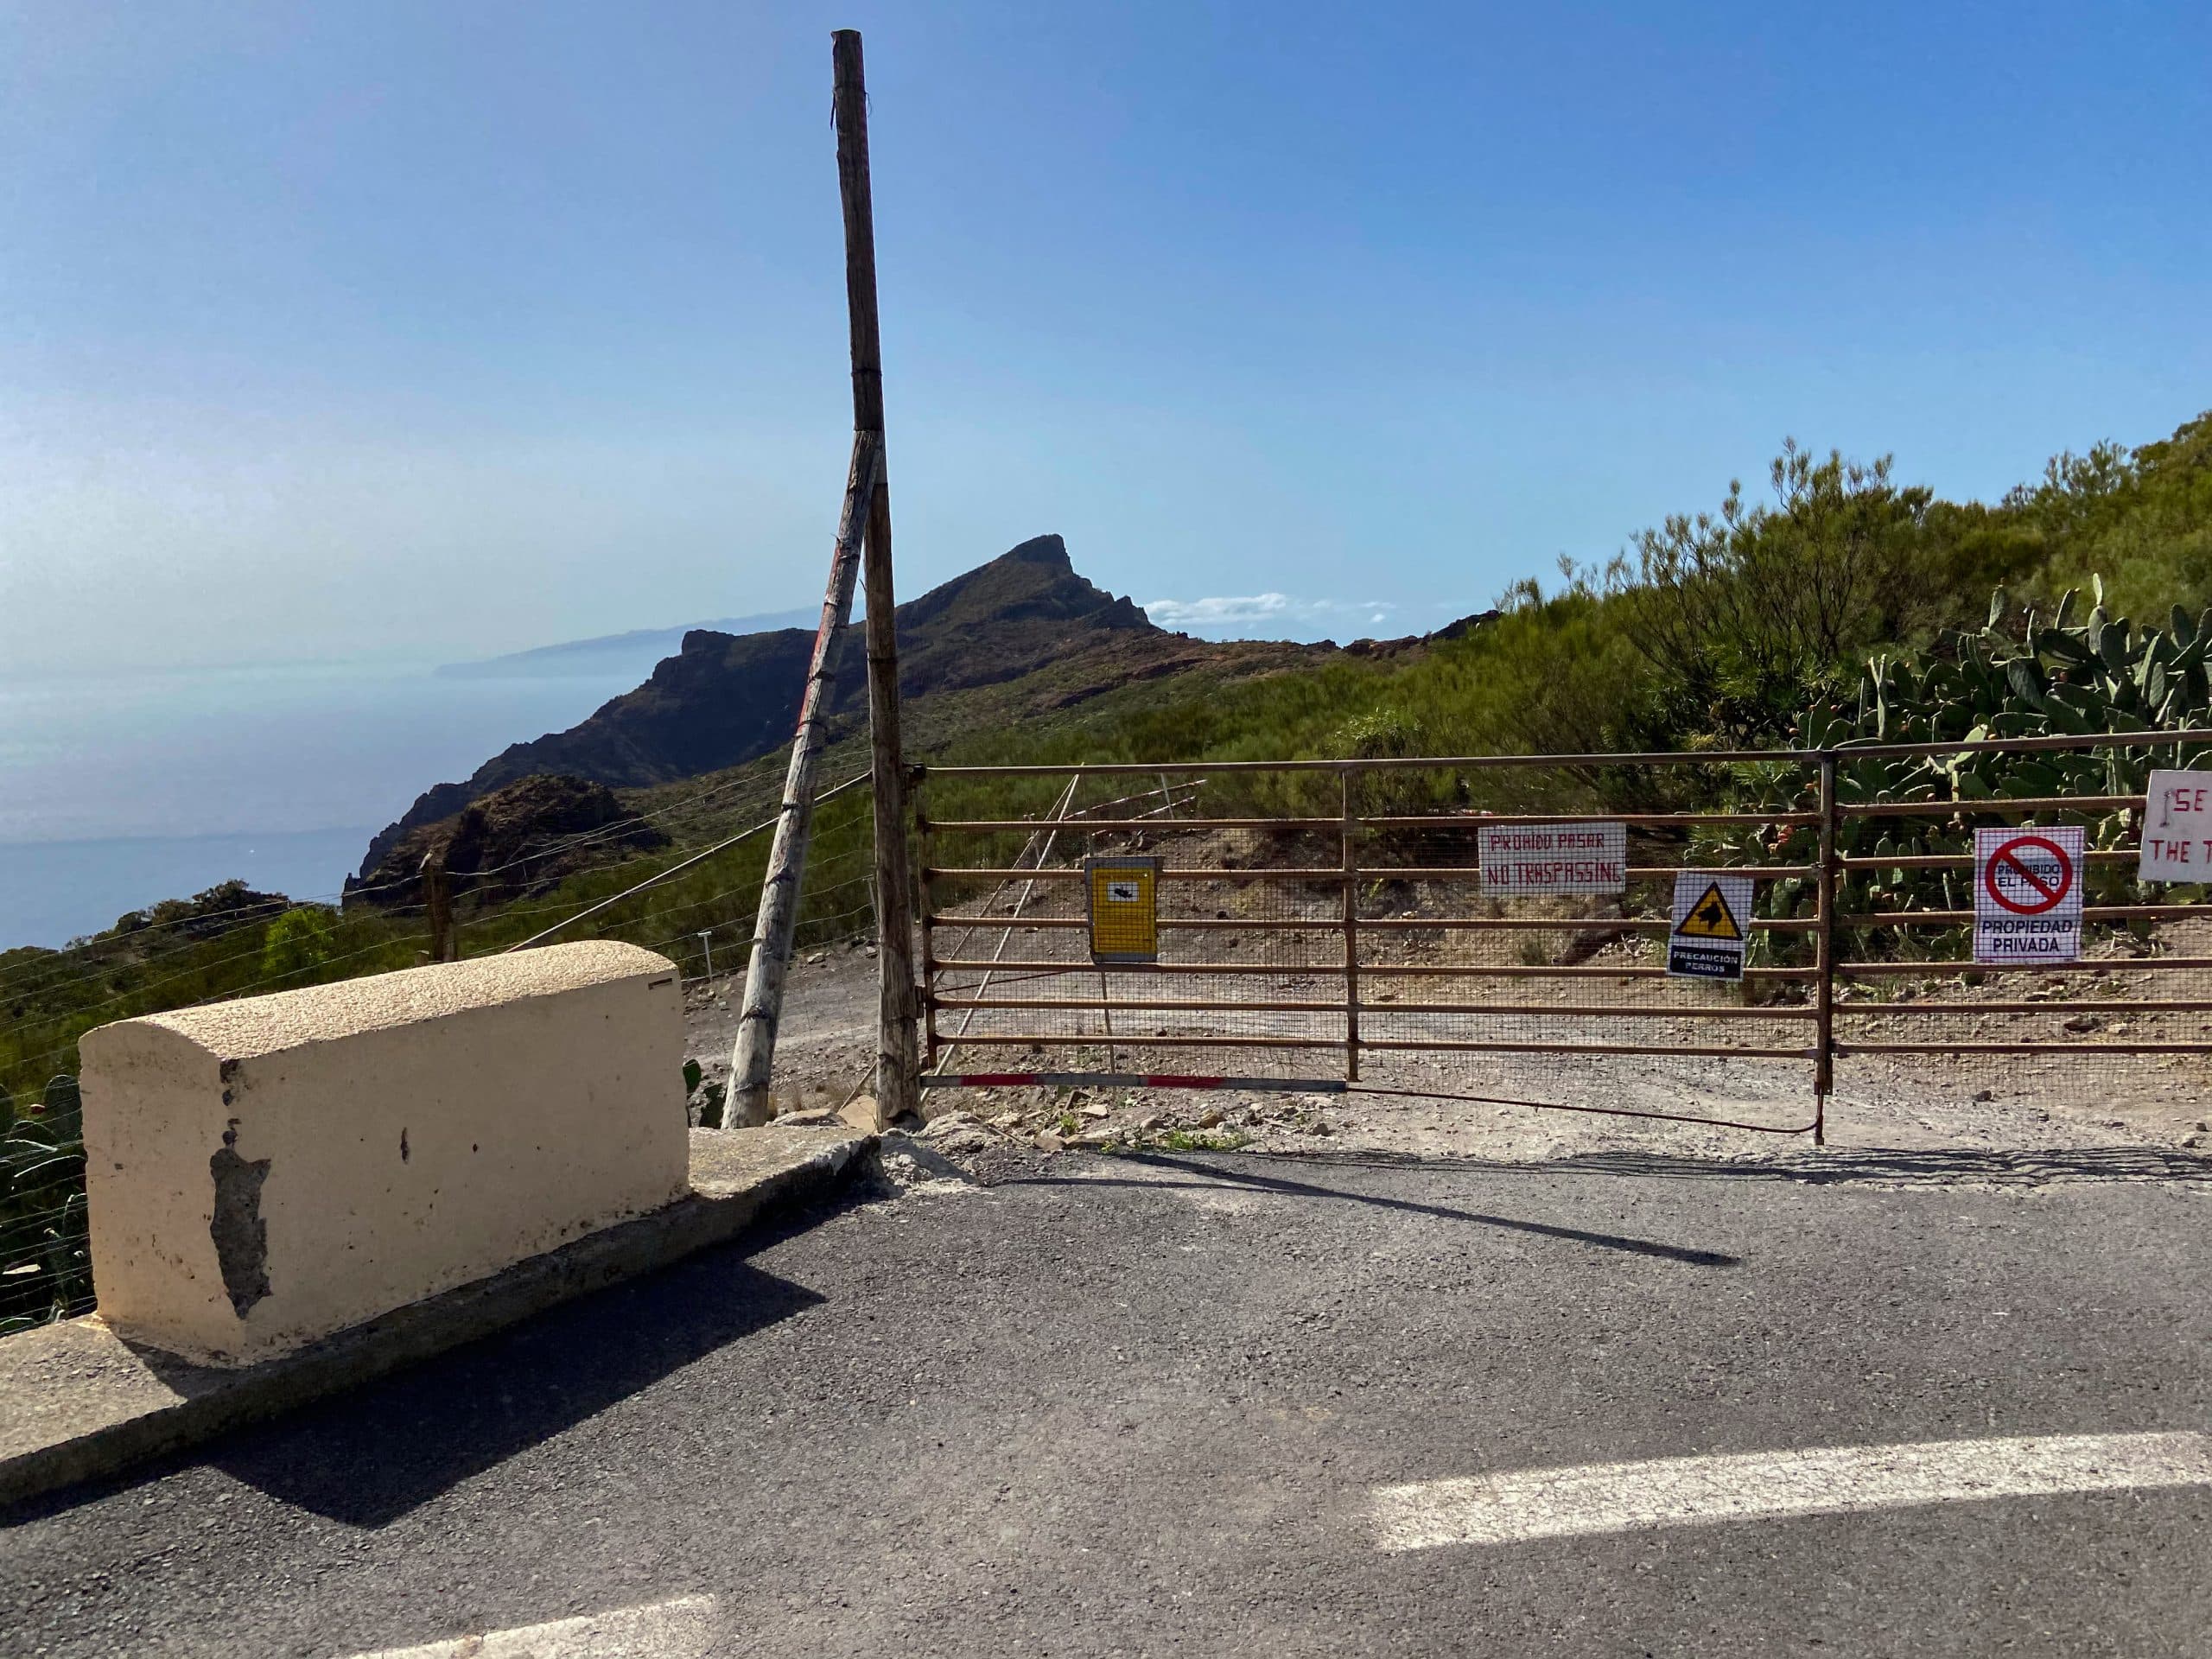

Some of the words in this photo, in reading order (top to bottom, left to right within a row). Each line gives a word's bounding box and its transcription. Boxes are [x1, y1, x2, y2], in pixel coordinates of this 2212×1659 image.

[1558, 833, 1605, 849] PASAR
[2149, 839, 2191, 863] THE
[1488, 864, 1510, 885] NO
[1998, 876, 2016, 887] EL
[2021, 876, 2060, 887] PSO
[1982, 920, 2073, 934] PROPIEDAD
[1993, 938, 2060, 952] PRIVADA
[1674, 951, 1738, 964] PRECAUCIÓN
[1685, 962, 1726, 973] PERROS
